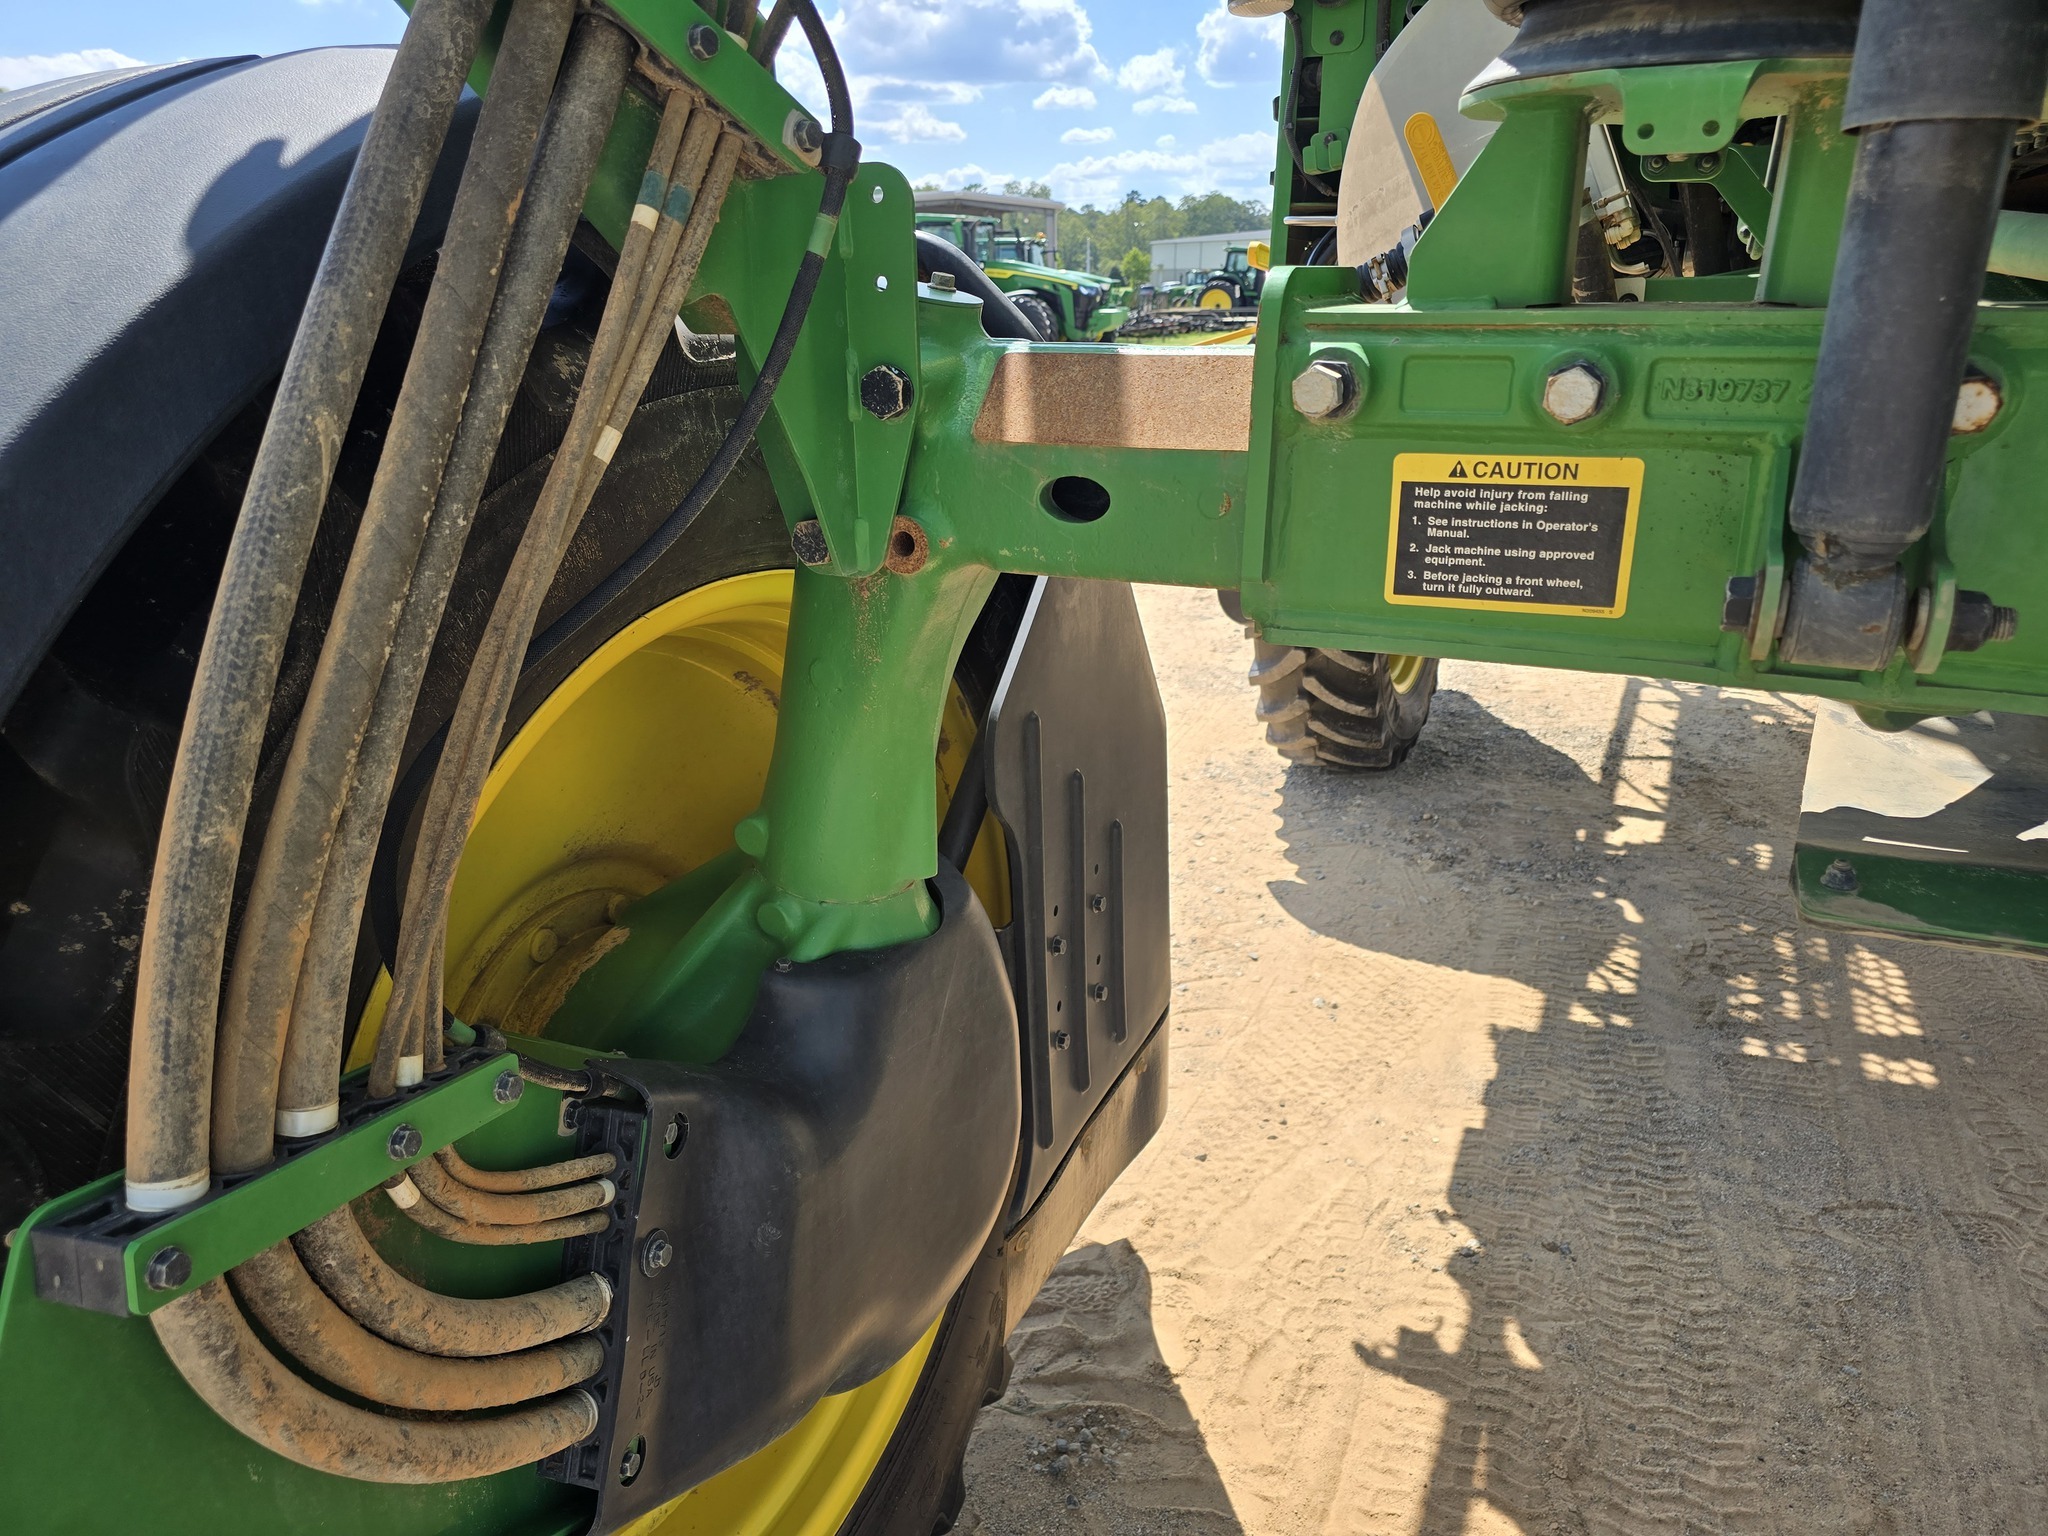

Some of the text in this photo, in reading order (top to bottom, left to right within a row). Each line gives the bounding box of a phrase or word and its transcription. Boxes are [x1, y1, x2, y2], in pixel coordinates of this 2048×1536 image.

[1473, 461, 1579, 480] CAUTION
[1415, 487, 1588, 503] Help avoid injury from falling
[1414, 500, 1547, 514] machine while jacking:
[1413, 516, 1598, 532] 1. See instructions in Operator's
[1427, 527, 1469, 538] Manual.
[1410, 543, 1594, 562] 2. Jack machine using approved
[1425, 556, 1485, 568] equipment.
[1408, 570, 1416, 579] 3.
[1424, 571, 1459, 581] Before
[1462, 573, 1502, 587] jacking
[1516, 576, 1543, 586] front
[1546, 578, 1583, 589] wheel,
[1423, 582, 1534, 597] turn it fully outward.
